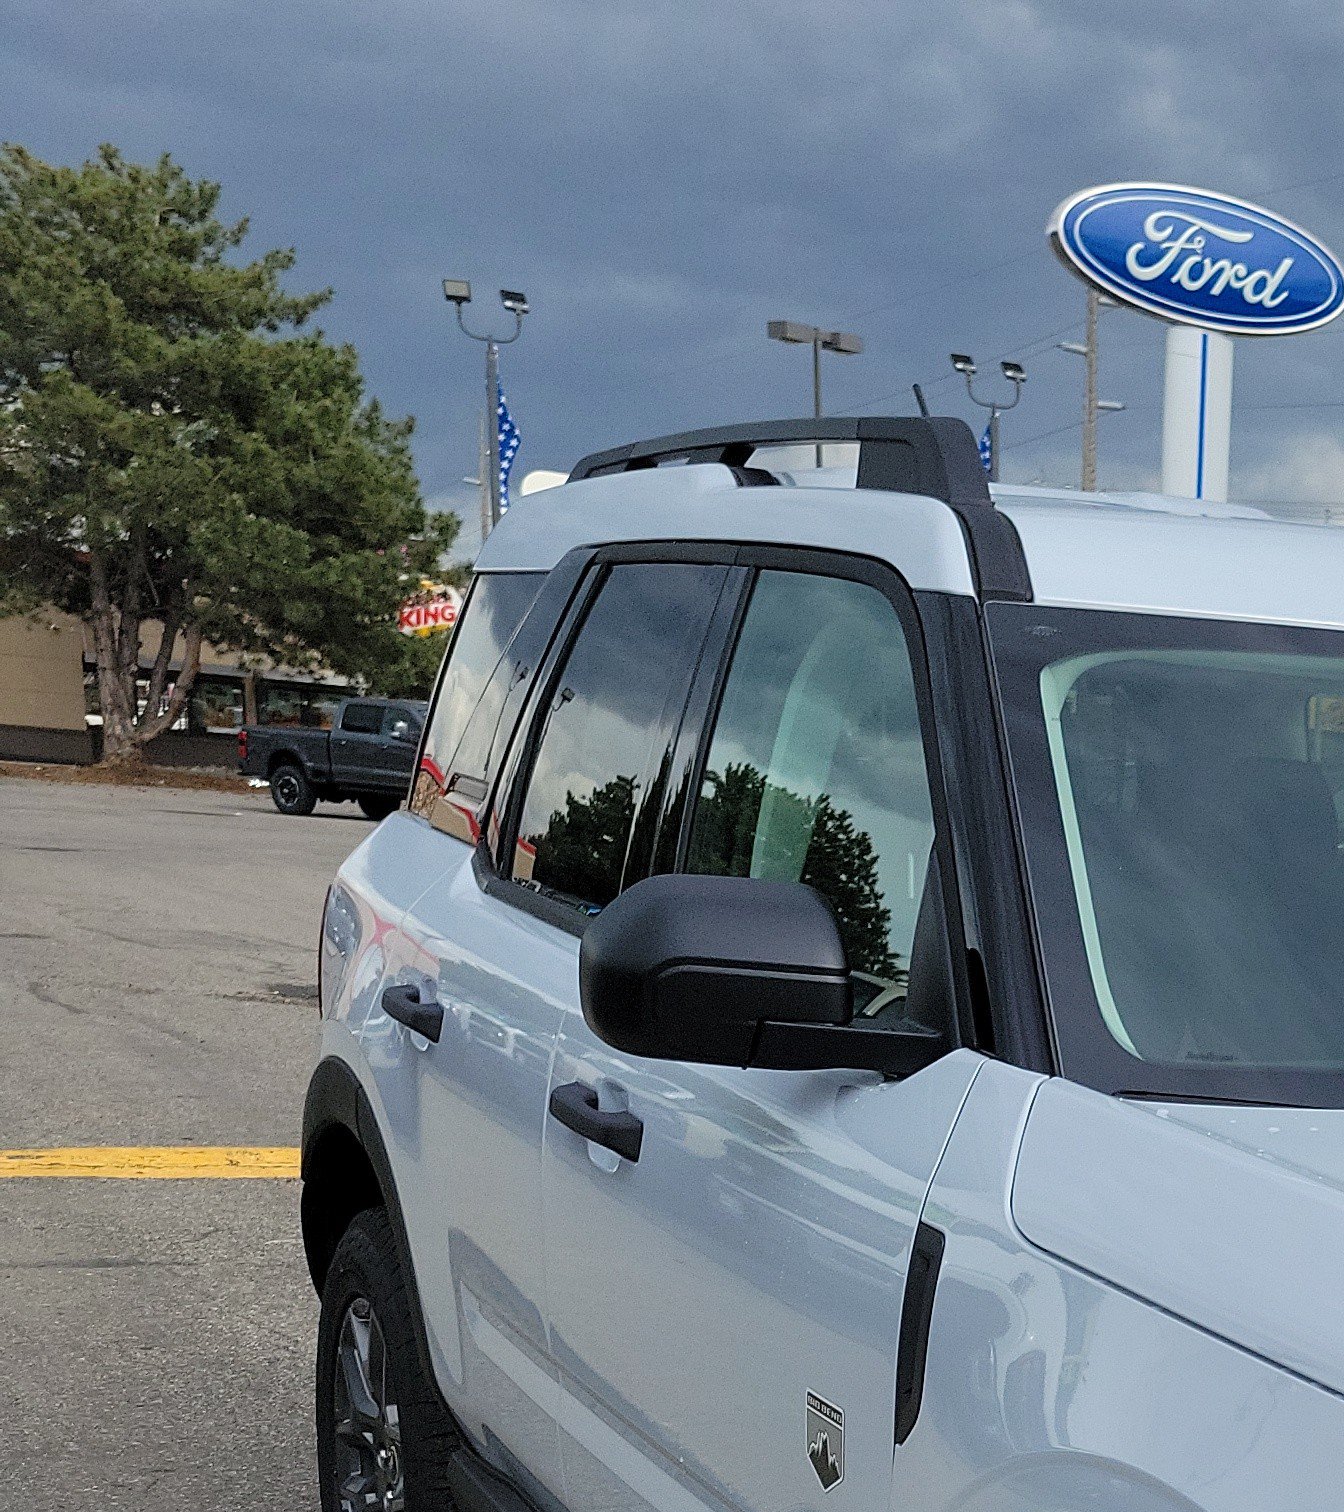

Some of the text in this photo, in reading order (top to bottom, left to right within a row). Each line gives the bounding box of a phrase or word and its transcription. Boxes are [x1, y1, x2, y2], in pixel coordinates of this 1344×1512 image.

[1126, 210, 1294, 308] Ford
[398, 604, 456, 629] KING
[821, 1404, 842, 1424] BEND
